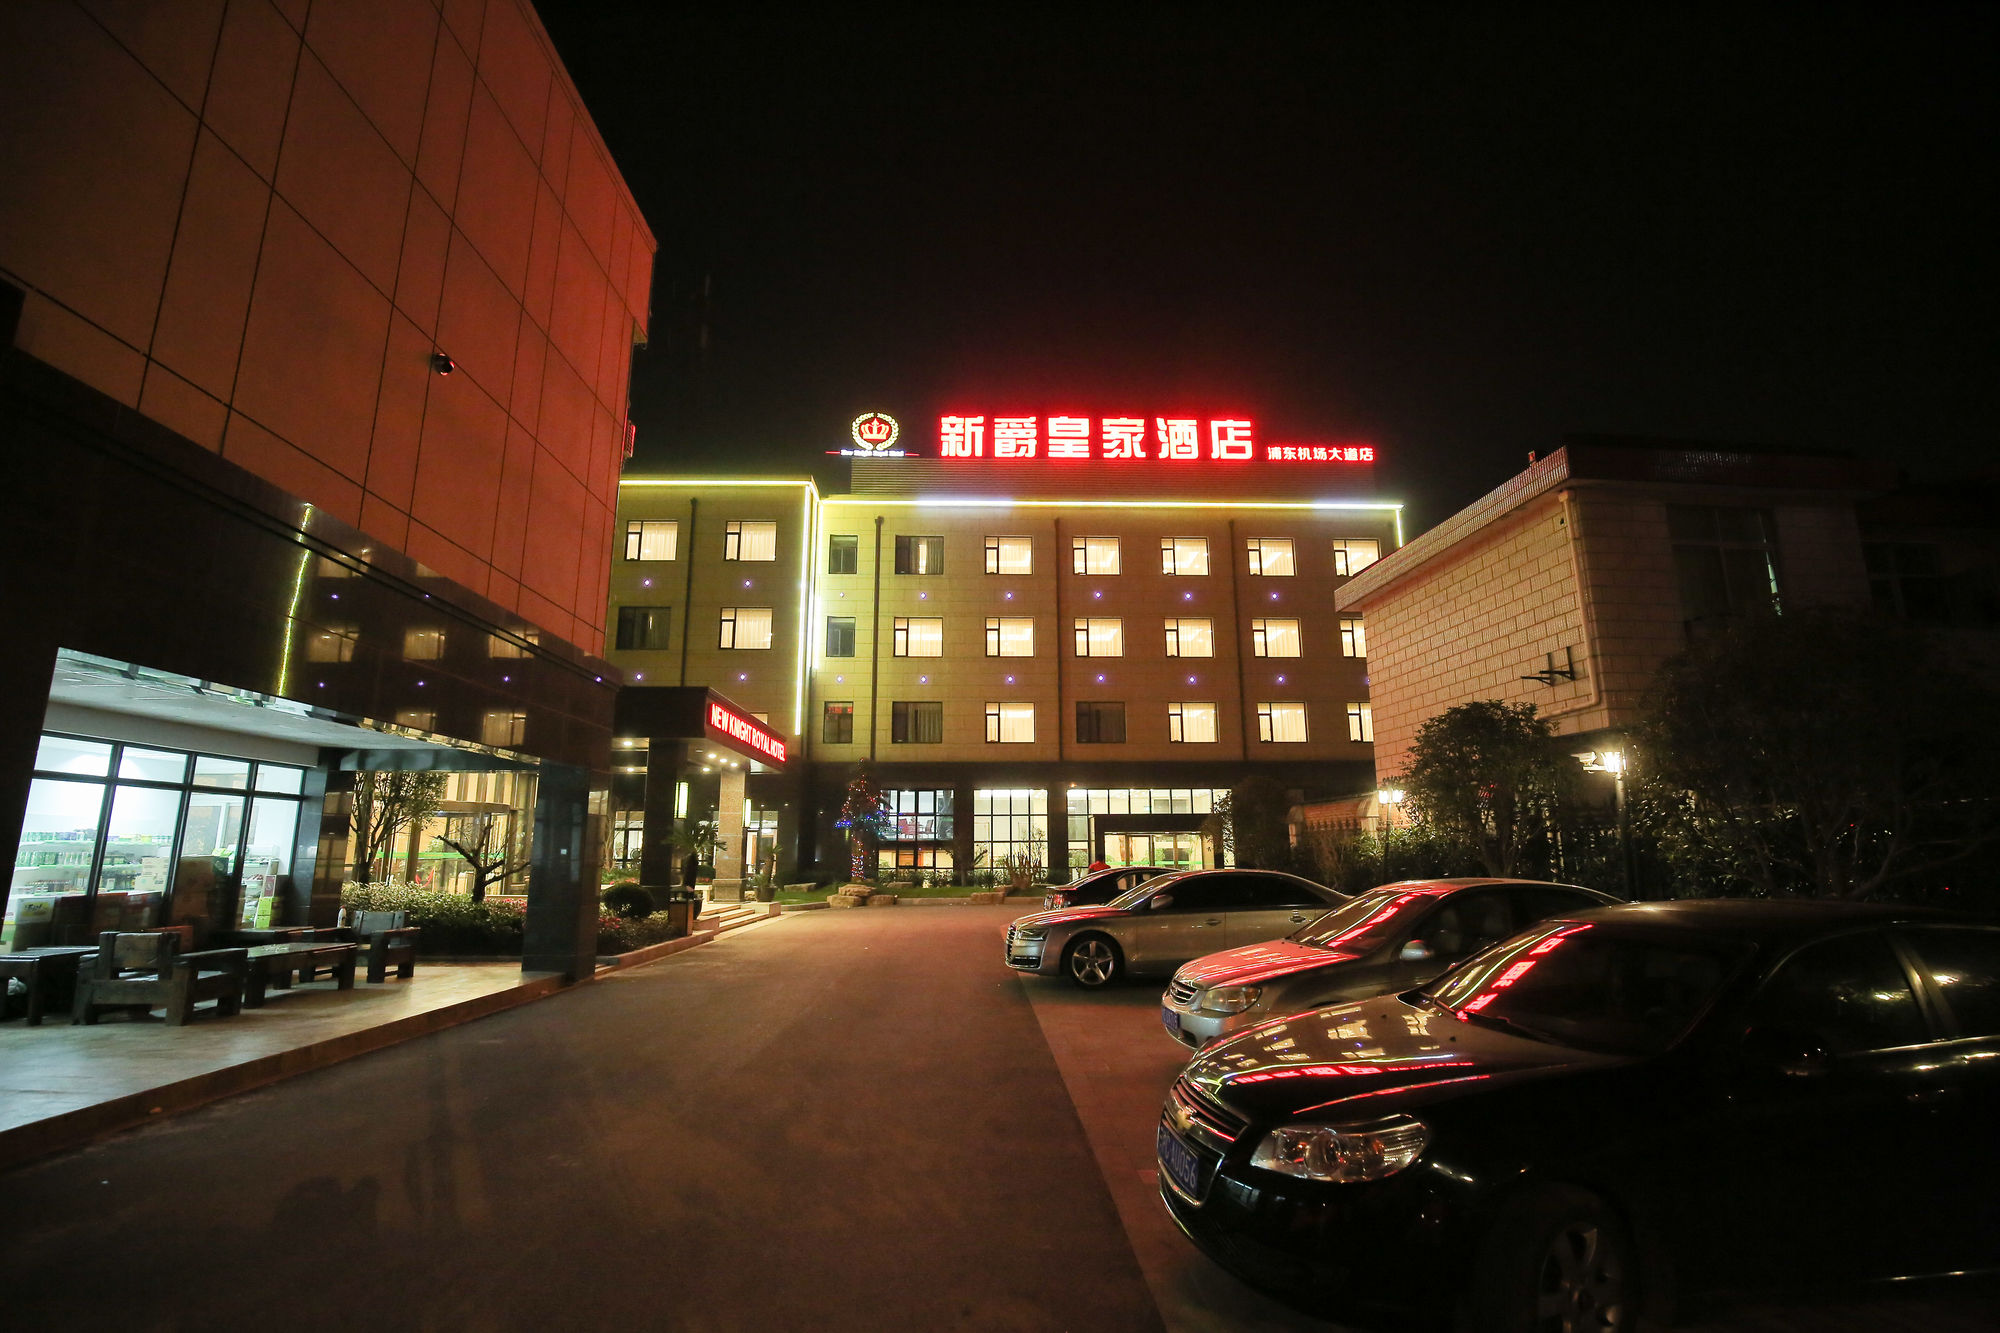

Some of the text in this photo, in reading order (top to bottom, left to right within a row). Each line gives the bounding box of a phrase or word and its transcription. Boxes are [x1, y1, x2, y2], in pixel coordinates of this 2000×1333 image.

[940, 416, 1253, 460] 新爵皇家酒店
[1267, 446, 1374, 461] 浦东机场大道店
[711, 703, 786, 762] NEW KNIGHT ROYAL HOTEL
